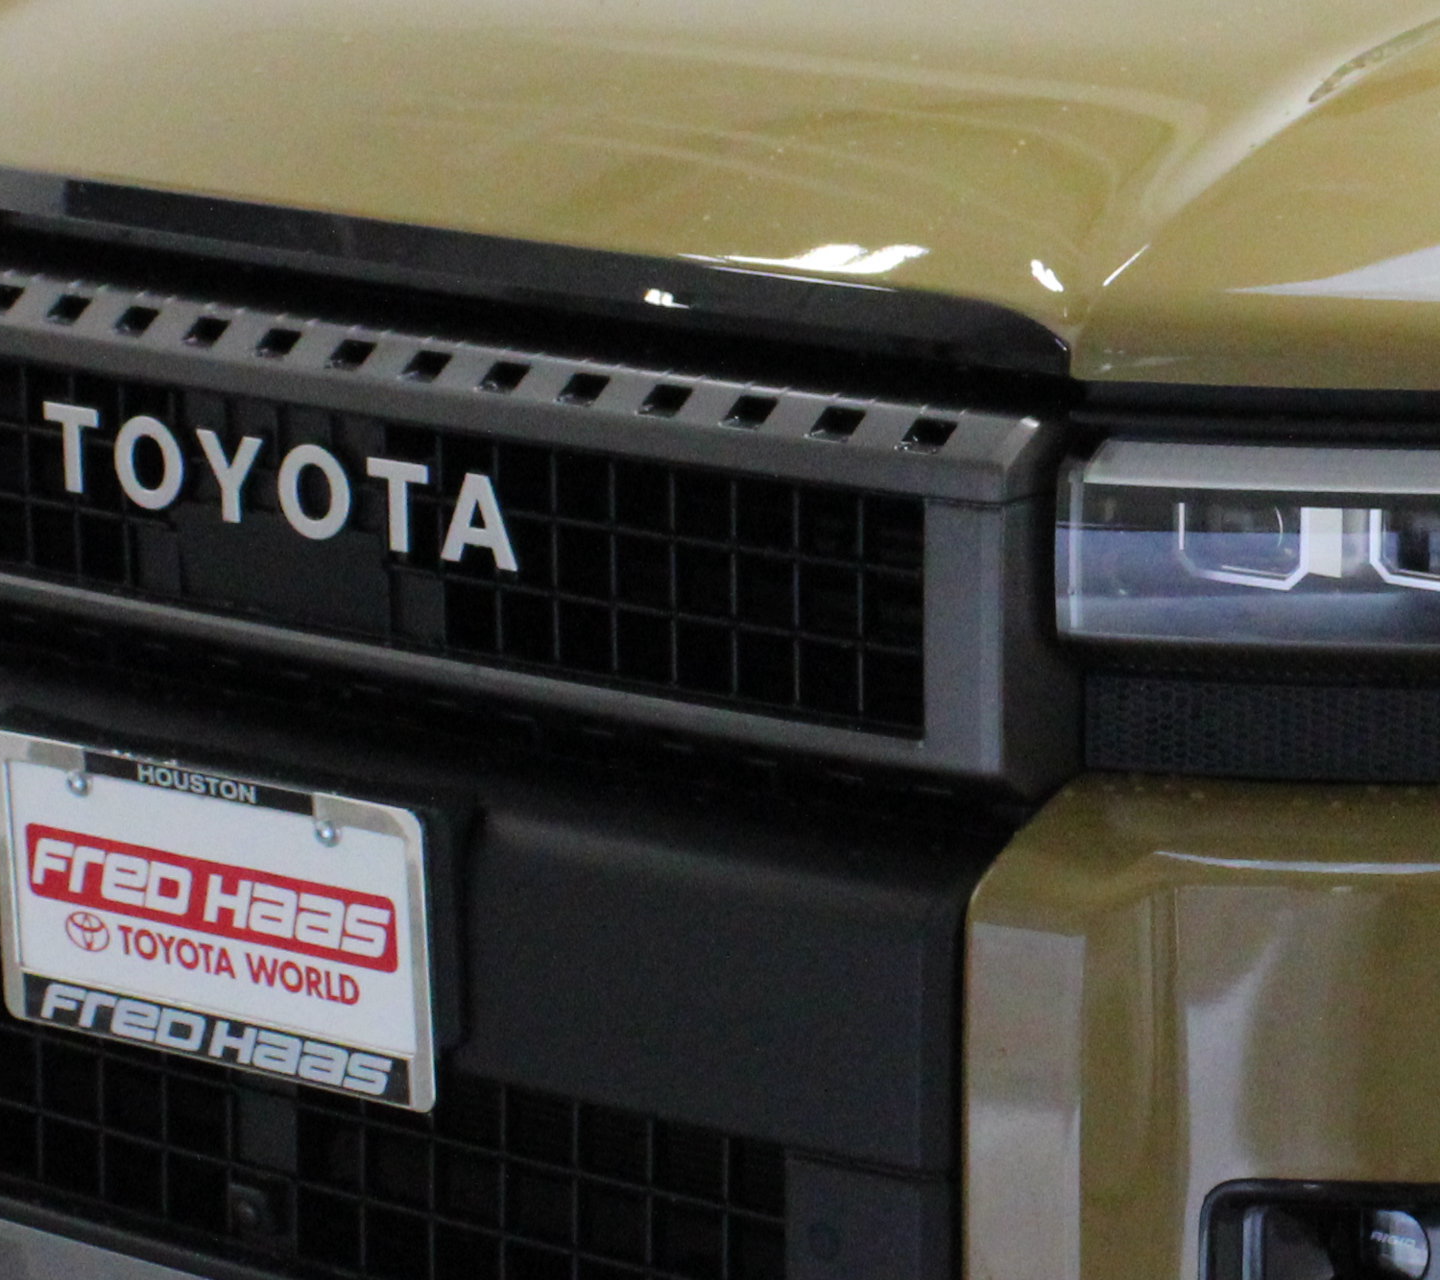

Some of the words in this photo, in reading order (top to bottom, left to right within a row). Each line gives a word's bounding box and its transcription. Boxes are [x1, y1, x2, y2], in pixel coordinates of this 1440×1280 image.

[43, 400, 519, 572] TOYOTA
[137, 763, 258, 805] HOUSTON
[117, 924, 237, 980] TOYOTA
[245, 951, 361, 1006] WORLD
